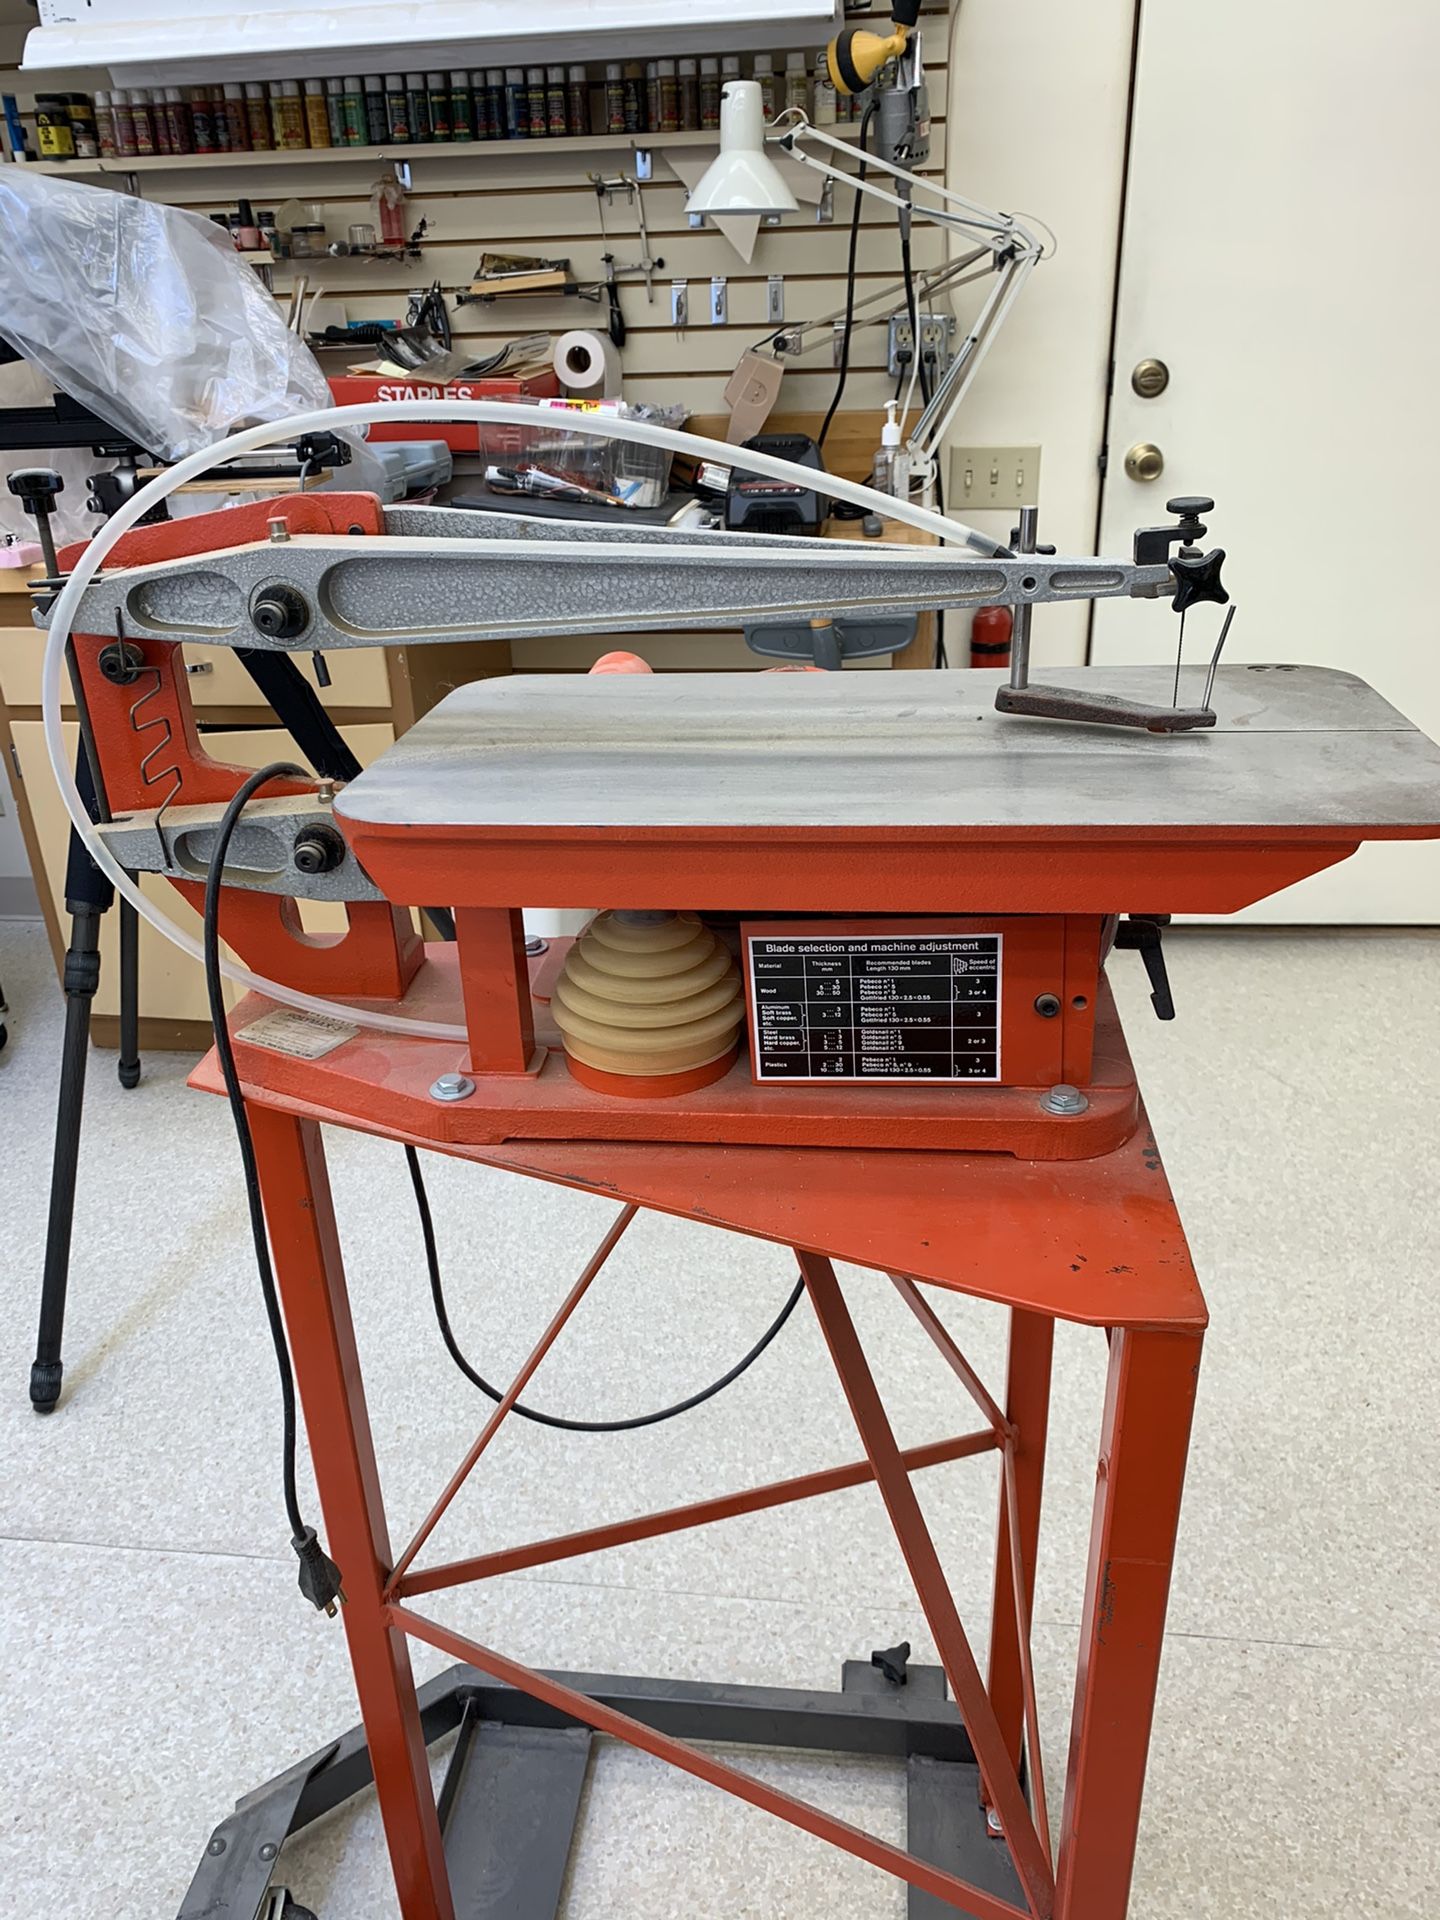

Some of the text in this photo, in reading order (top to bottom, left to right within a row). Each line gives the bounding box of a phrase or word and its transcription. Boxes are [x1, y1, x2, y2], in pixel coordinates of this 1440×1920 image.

[378, 385, 472, 402] STAPLES
[766, 941, 979, 953] Blade selection and machine adjustment
